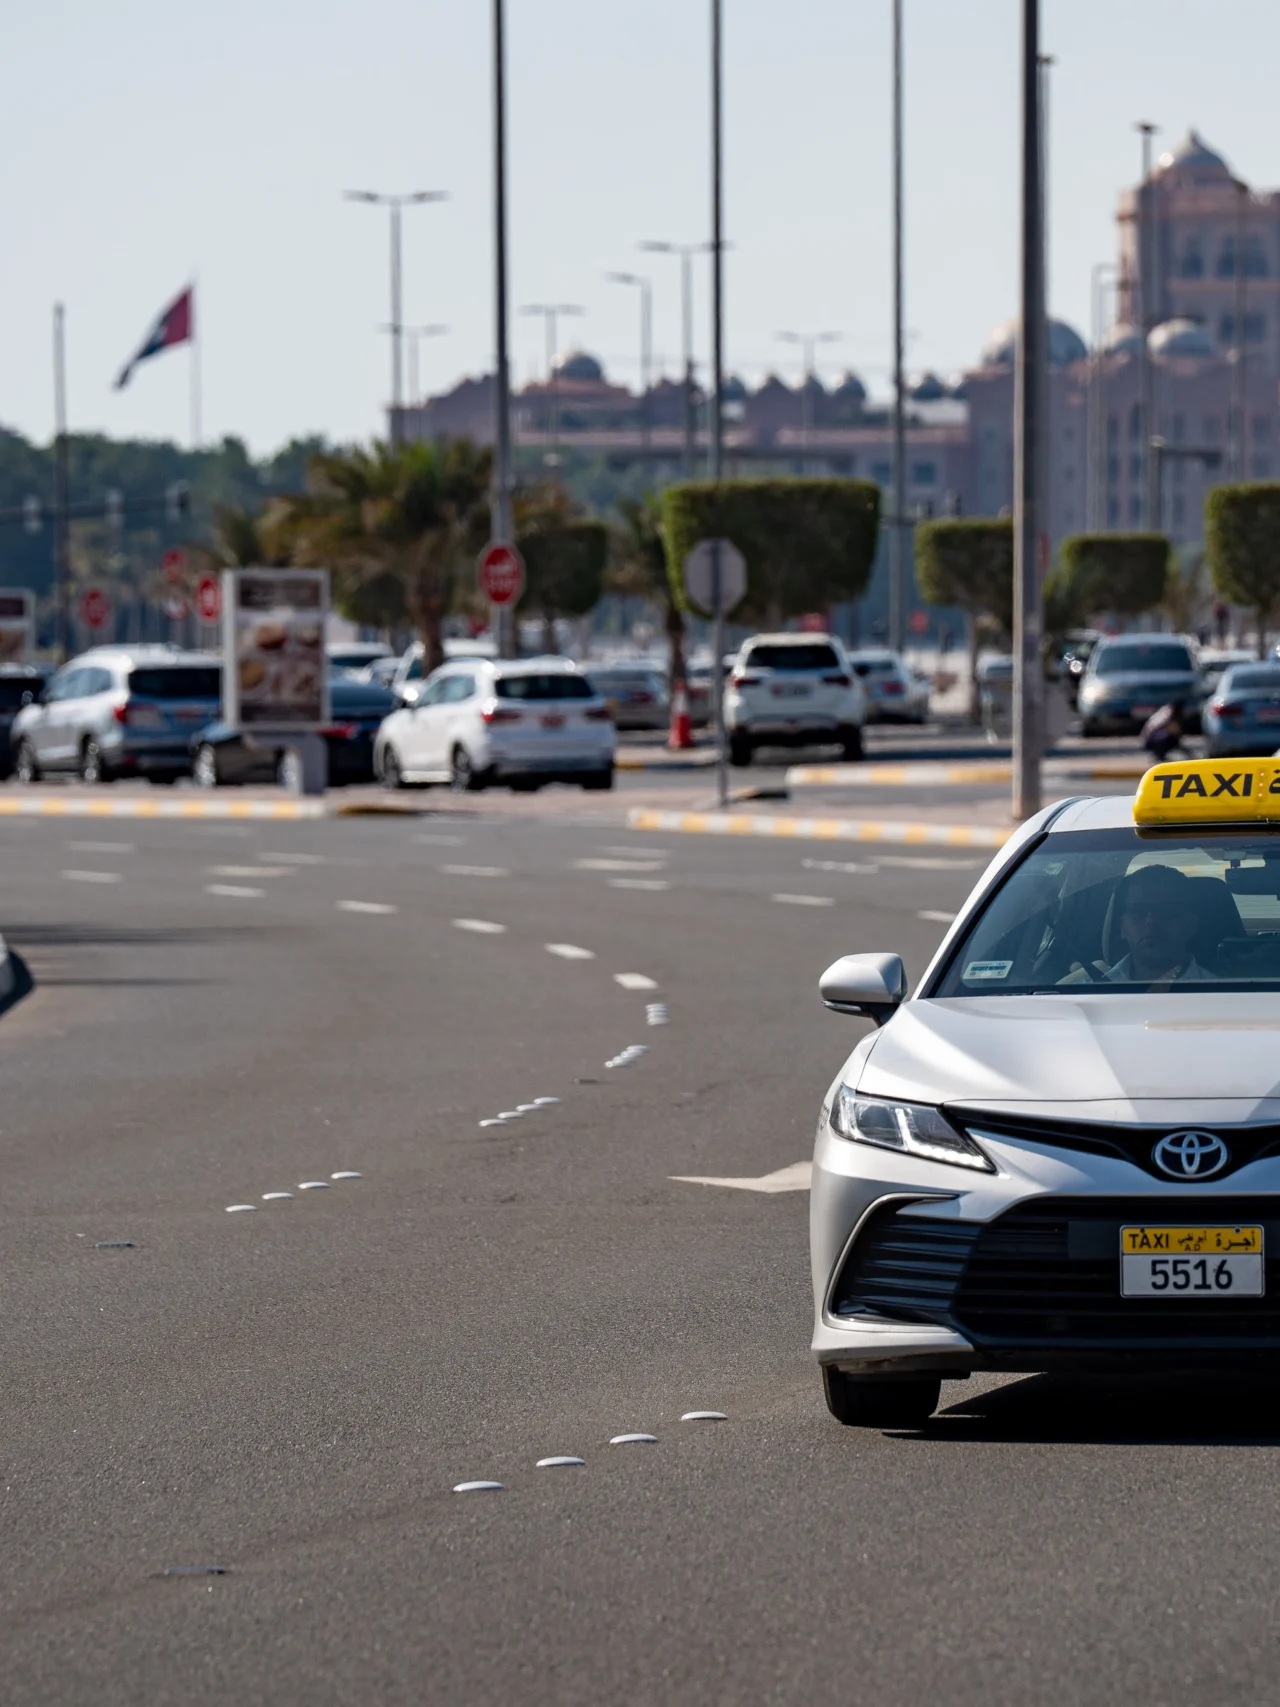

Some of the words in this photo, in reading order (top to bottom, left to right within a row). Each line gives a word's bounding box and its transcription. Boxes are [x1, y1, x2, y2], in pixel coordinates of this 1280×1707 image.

[1153, 773, 1254, 799] TAXI
[1128, 1233, 1169, 1249] TAXI
[1215, 1229, 1256, 1251] أجرة
[1150, 1259, 1233, 1290] 5516
